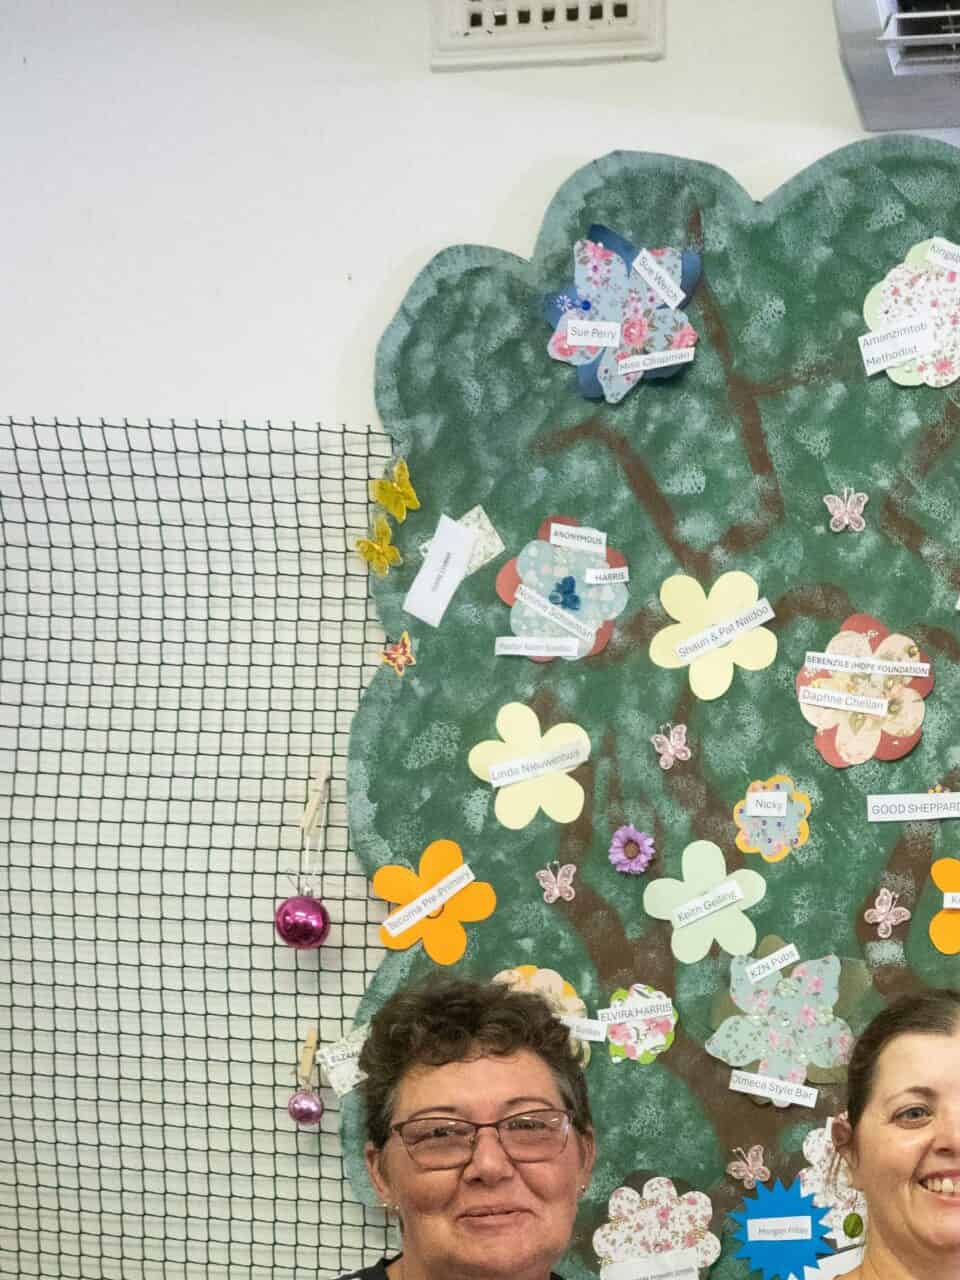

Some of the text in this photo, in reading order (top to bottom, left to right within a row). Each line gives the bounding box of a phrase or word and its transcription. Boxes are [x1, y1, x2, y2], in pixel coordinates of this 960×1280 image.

[570, 326, 617, 340] Sue Perry
[862, 322, 928, 347] Amanzimtoti
[866, 344, 918, 367] Methodist
[678, 605, 769, 658] Shaun & Pat Naidoo
[877, 663, 929, 676] FOUNDATION
[871, 803, 906, 816] GOOD
[768, 1082, 793, 1096] Style
[794, 1087, 815, 1100] Bar
